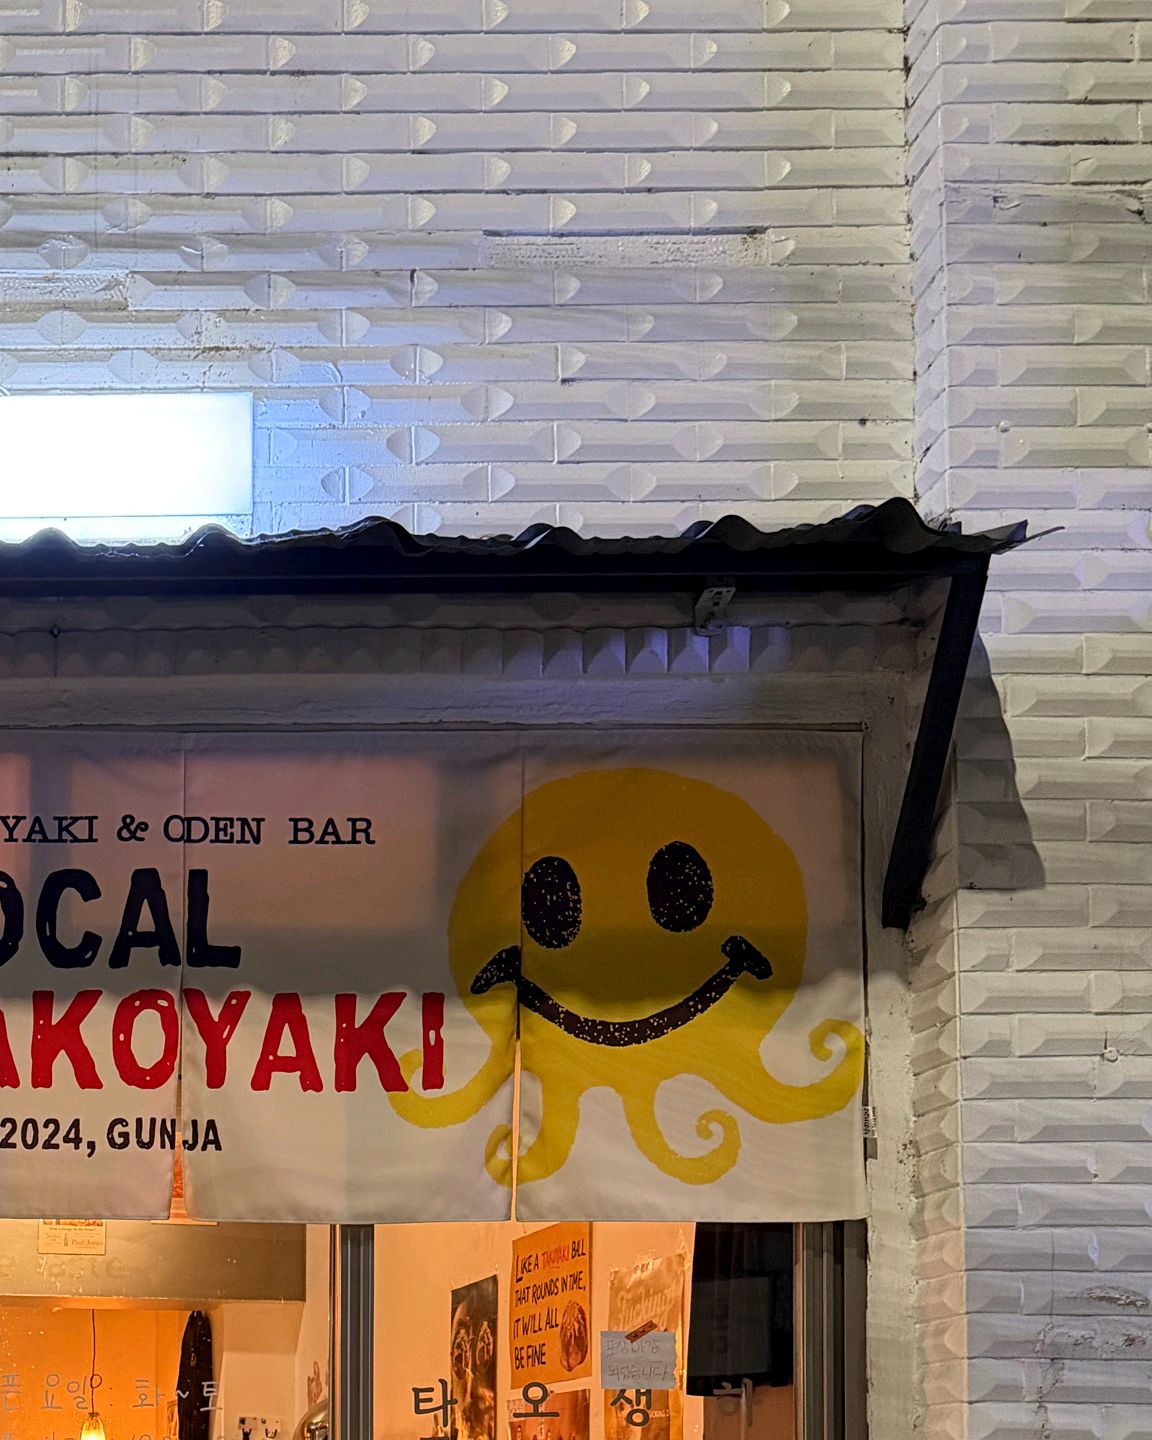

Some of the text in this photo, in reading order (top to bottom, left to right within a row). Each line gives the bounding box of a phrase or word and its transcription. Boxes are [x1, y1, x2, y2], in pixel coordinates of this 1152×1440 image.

[116, 814, 149, 842] &
[163, 815, 266, 845] ODEN
[288, 817, 376, 845] BAR
[533, 1252, 539, 1270] A
[515, 1286, 531, 1307] THAT
[532, 1279, 559, 1304] ROUNDS
[561, 1275, 568, 1293] IN
[513, 1306, 559, 1339] IT WILL ALL
[514, 1343, 546, 1369] BE FINE
